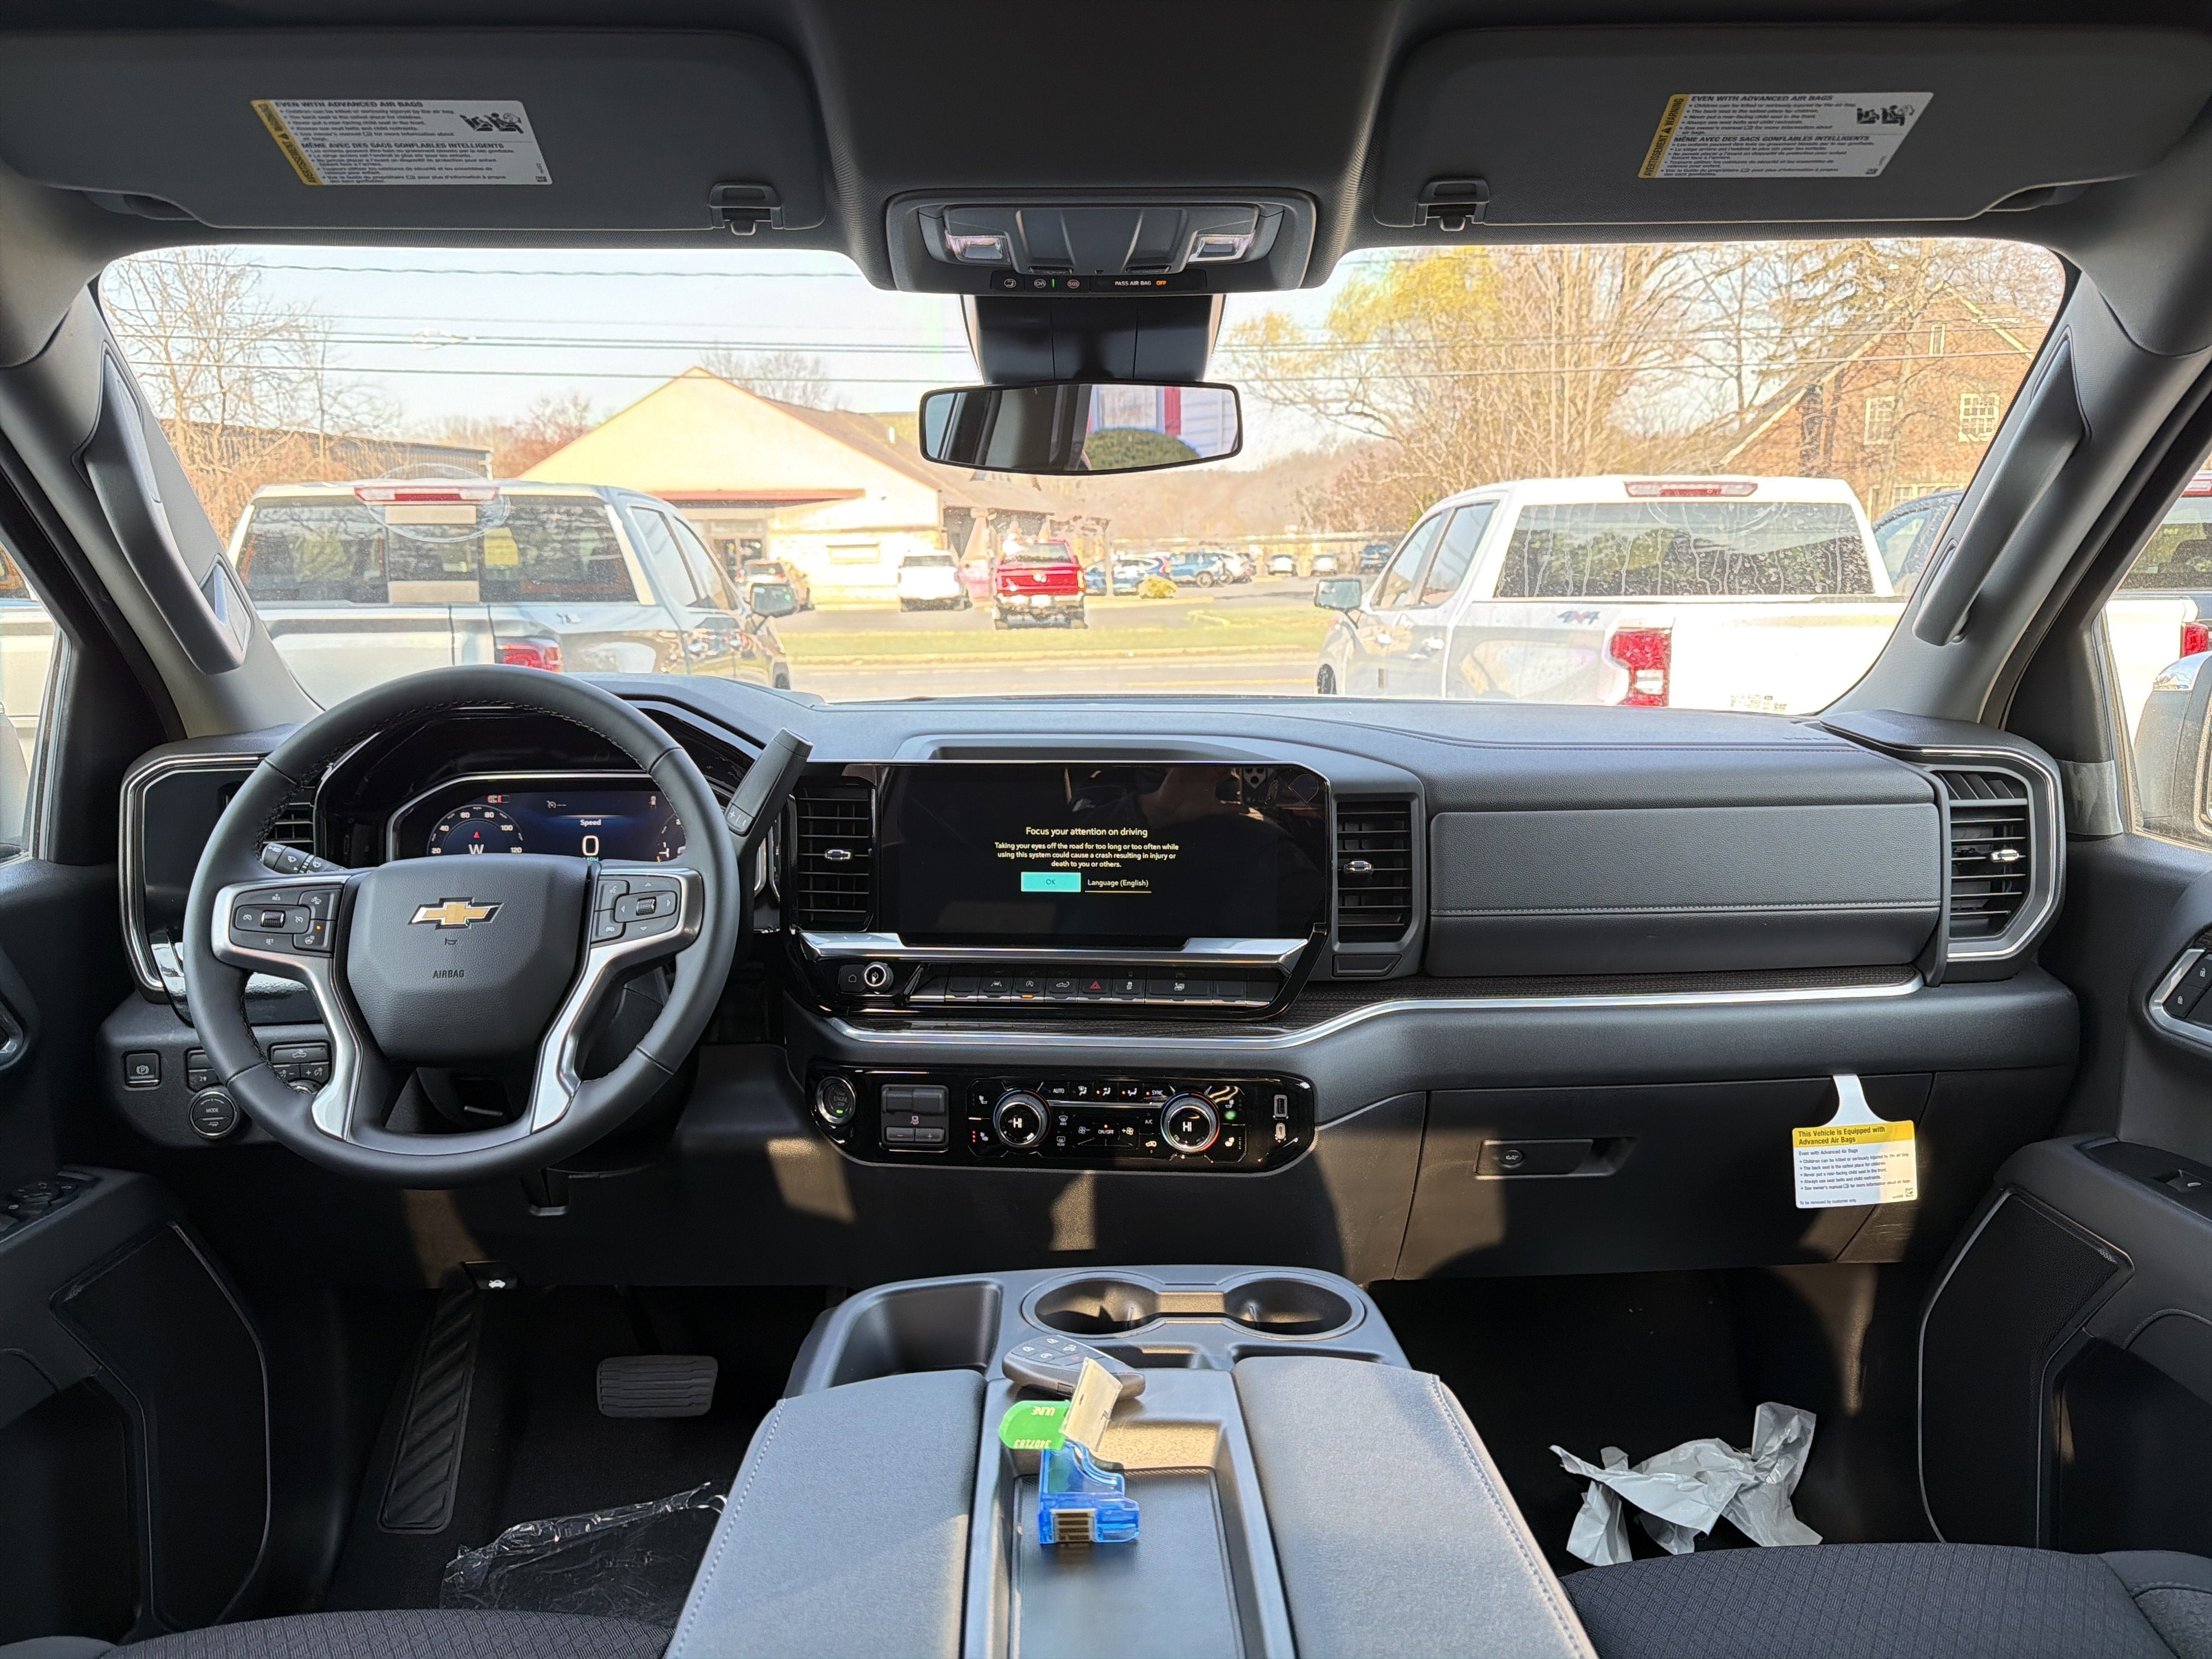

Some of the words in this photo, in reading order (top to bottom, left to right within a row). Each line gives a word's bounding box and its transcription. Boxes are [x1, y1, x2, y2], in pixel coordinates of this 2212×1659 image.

[1664, 98, 1684, 126] WARNING
[579, 819, 602, 827] Speed
[1026, 826, 1049, 836] Focus
[1051, 828, 1069, 838] your
[1070, 827, 1107, 836] attention
[1120, 827, 1148, 838] driving
[468, 844, 484, 855] W
[582, 835, 599, 856] 0
[994, 842, 1015, 851] Taking
[1046, 842, 1057, 850] off
[1107, 842, 1122, 852] long
[997, 851, 1015, 860] using
[1113, 851, 1142, 861] resulting
[1149, 852, 1168, 861] injury
[1078, 861, 1090, 870] you
[1087, 879, 1119, 888] Language
[1120, 879, 1149, 888] (English)
[432, 970, 465, 979] AIRBAG
[1013, 1118, 1022, 1128] HI
[1182, 1121, 1192, 1132] HI
[1843, 1126, 1871, 1136] Equipped
